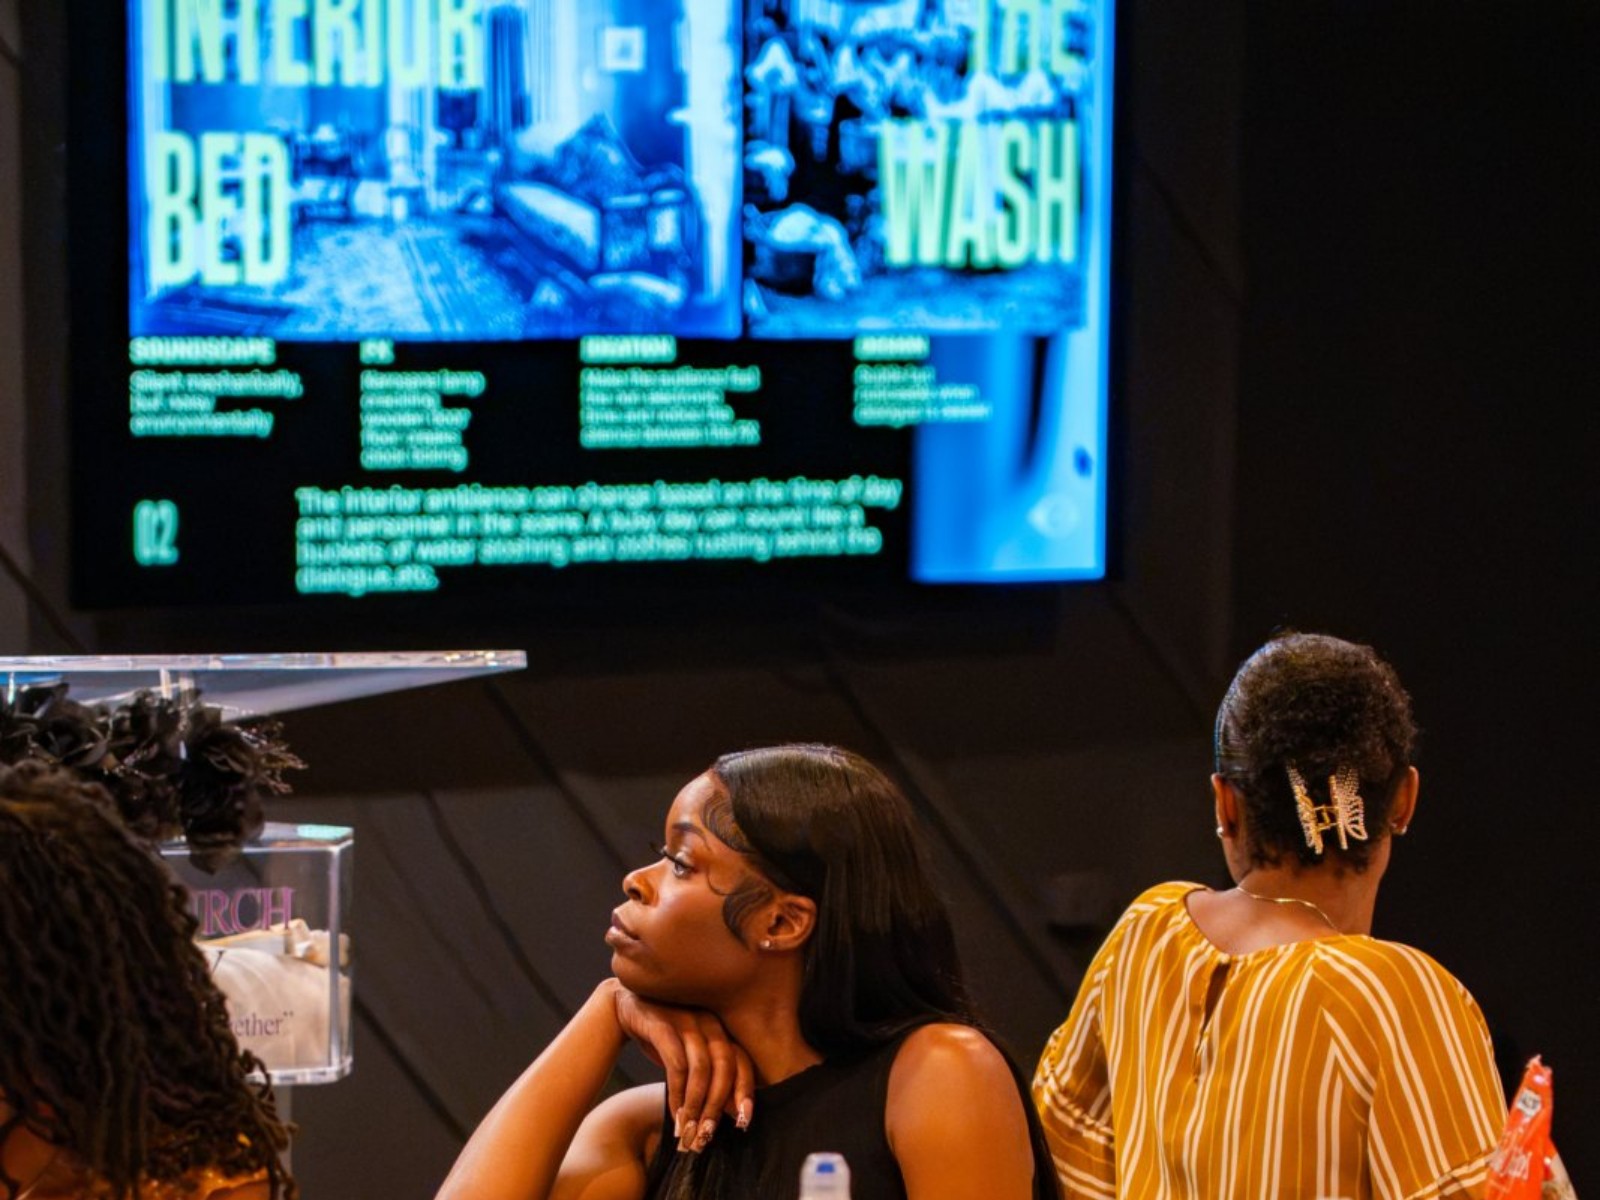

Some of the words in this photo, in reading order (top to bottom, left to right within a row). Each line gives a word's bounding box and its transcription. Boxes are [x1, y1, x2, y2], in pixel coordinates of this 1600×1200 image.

[152, 0, 484, 89] INTERIOR
[151, 131, 293, 288] BED
[878, 119, 1078, 267] WASH
[191, 886, 295, 937] RCH
